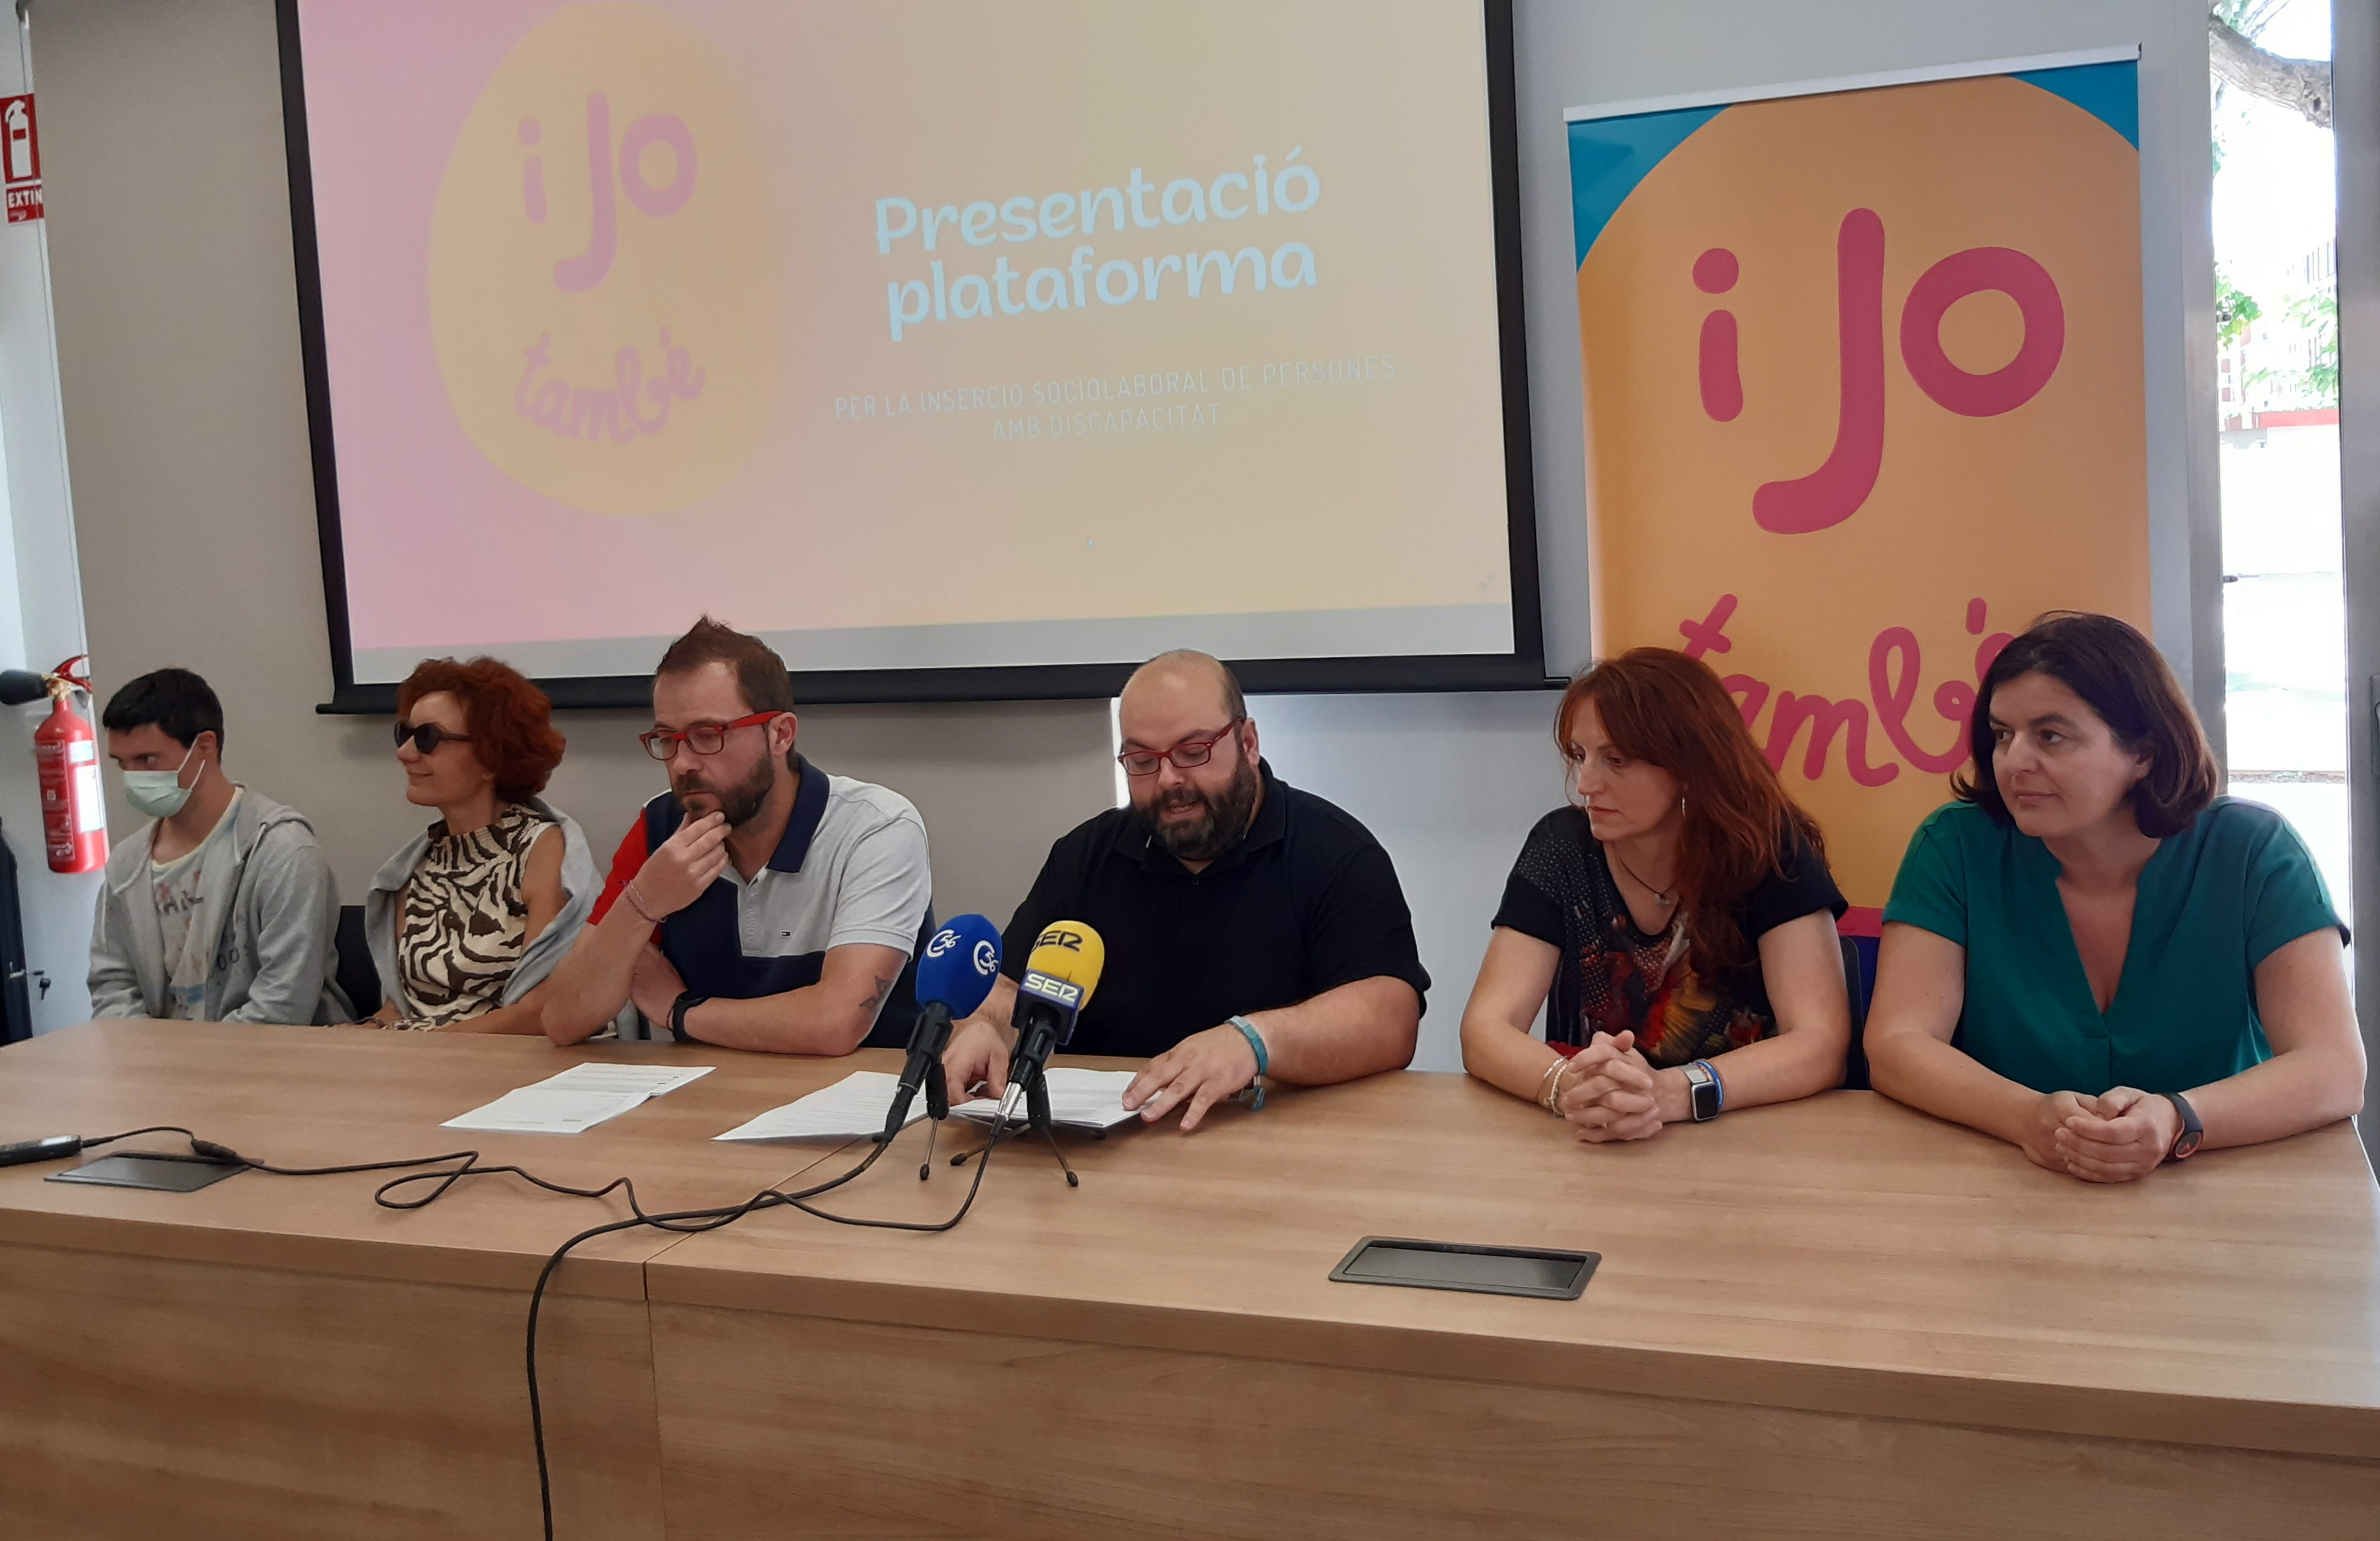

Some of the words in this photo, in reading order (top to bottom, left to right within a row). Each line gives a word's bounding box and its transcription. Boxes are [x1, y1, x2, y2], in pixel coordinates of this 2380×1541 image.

[875, 145, 1320, 255] Presentació
[887, 243, 1317, 342] plataforma
[835, 395, 876, 420] PER
[885, 393, 911, 416] LA
[1033, 370, 1211, 405] SOCIOLABORAL
[1222, 366, 1253, 391] DE
[1263, 355, 1396, 387] PERSONES
[993, 416, 1040, 440] AMB
[1050, 403, 1220, 437] DISCAPACITAT
[1024, 973, 1078, 1002] SER
